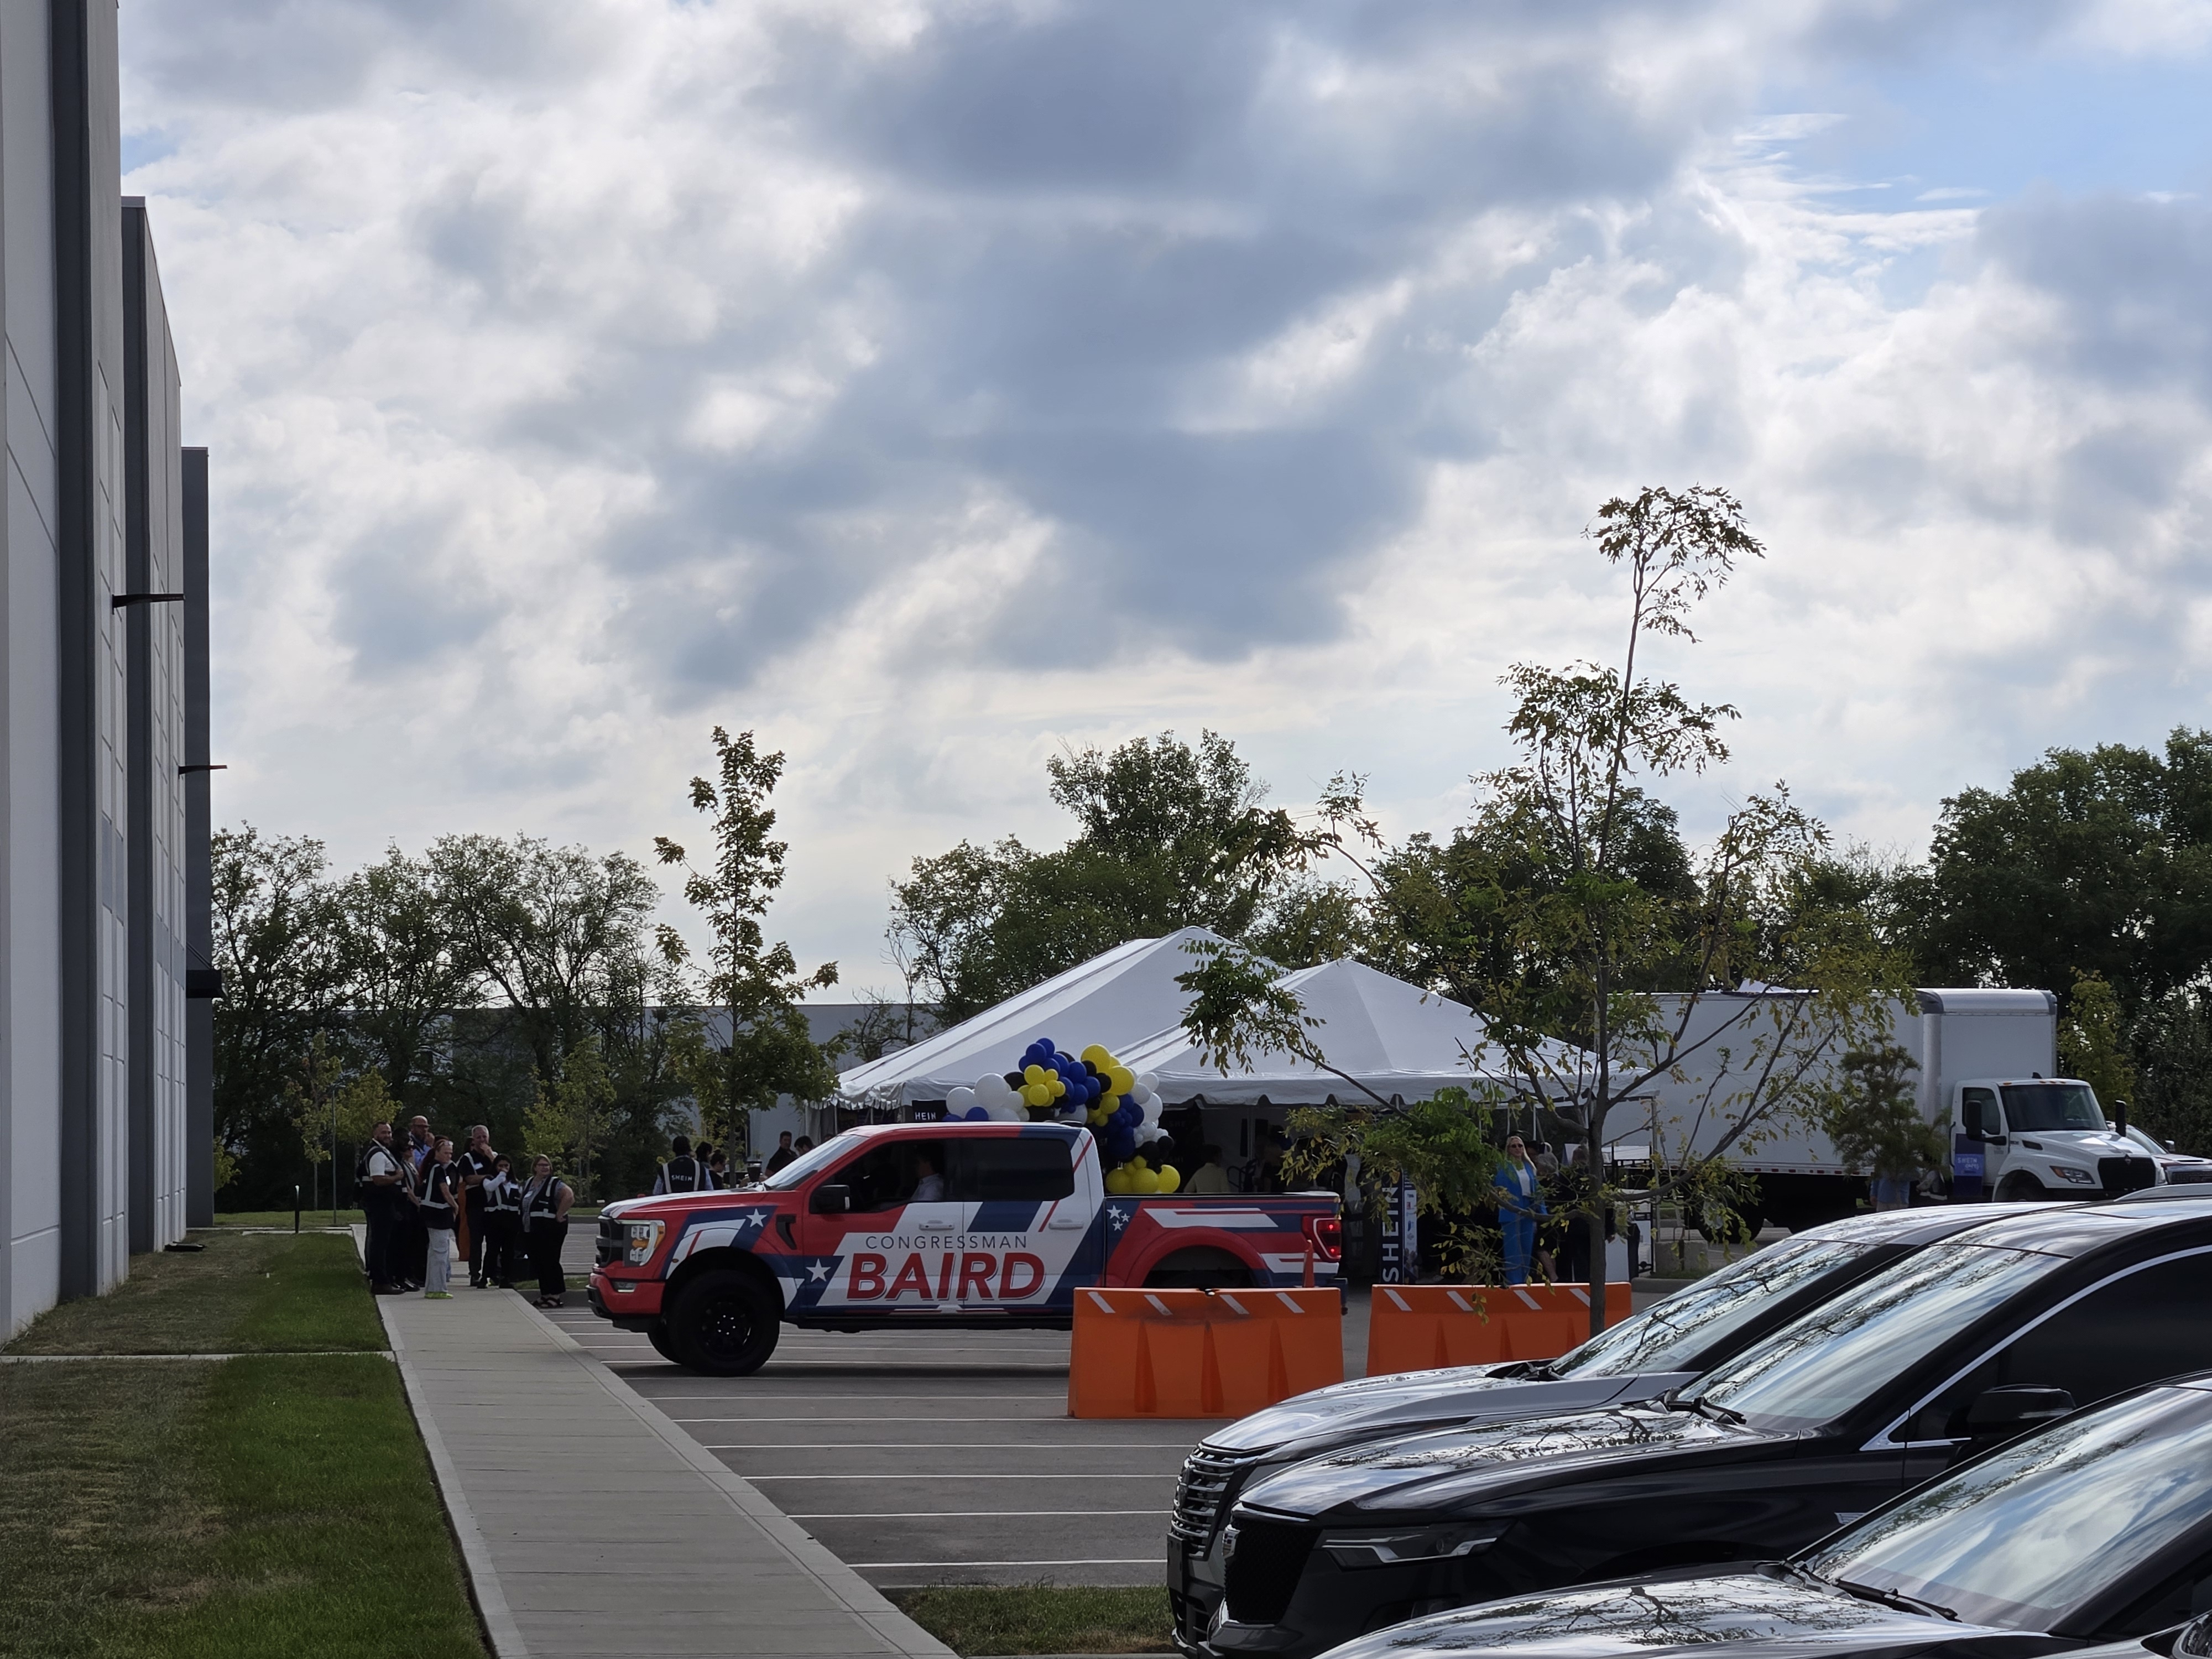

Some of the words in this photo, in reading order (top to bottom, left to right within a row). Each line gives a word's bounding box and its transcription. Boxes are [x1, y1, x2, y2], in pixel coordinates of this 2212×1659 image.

[865, 1235, 1027, 1249] CONGRESSMAN
[1382, 1187, 1400, 1282] SHEIN
[846, 1252, 1047, 1301] BAIRD
